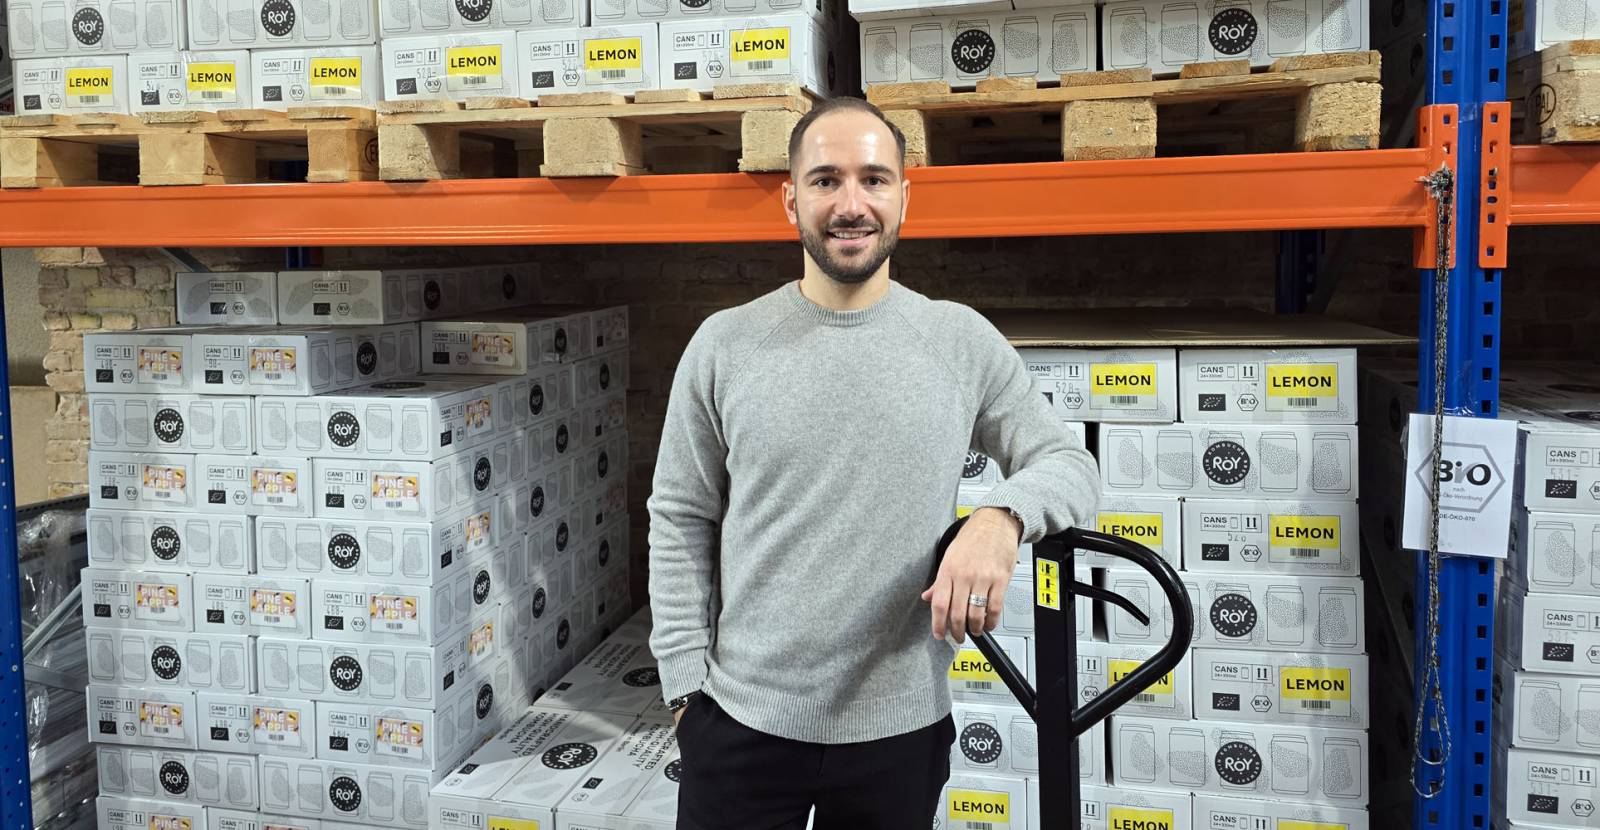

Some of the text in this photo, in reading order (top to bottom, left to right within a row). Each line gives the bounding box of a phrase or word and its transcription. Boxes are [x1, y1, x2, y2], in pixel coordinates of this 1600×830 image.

[736, 39, 784, 52] LEMON
[590, 49, 636, 60] LEMON
[451, 56, 496, 68] LEMON
[191, 72, 232, 82] LEMON
[314, 68, 356, 78] LEMON
[70, 78, 108, 88] LEMON
[1096, 376, 1150, 386] LEMON
[1272, 376, 1332, 388] LEMON
[965, 452, 979, 464] OY
[1550, 450, 1576, 458] CANS
[149, 470, 172, 480] PINE
[258, 472, 282, 482] PINE
[258, 483, 292, 493] APPLE
[378, 478, 404, 488] PINE
[378, 488, 414, 498] APPLE
[1204, 516, 1228, 524] CANS
[1276, 526, 1334, 539] LEMON
[142, 588, 164, 598] PINE
[256, 594, 280, 604] PINE
[376, 600, 401, 608] PINE
[256, 604, 291, 614] APPLE
[376, 609, 412, 619] APPLE
[952, 662, 992, 672] LEMO
[1214, 666, 1238, 674] CANS
[1286, 678, 1344, 691] LEMON
[145, 706, 168, 716] PINE
[260, 711, 284, 720] PINE
[146, 716, 180, 726] APPLE
[260, 720, 296, 731] APPLE
[382, 722, 408, 734] PINE
[382, 732, 418, 745] APPLE
[1532, 766, 1558, 774] CANS
[954, 801, 1004, 814] LEMON
[442, 810, 458, 818] CANS
[1213, 814, 1237, 823] CANS
[154, 819, 178, 828] PINE
